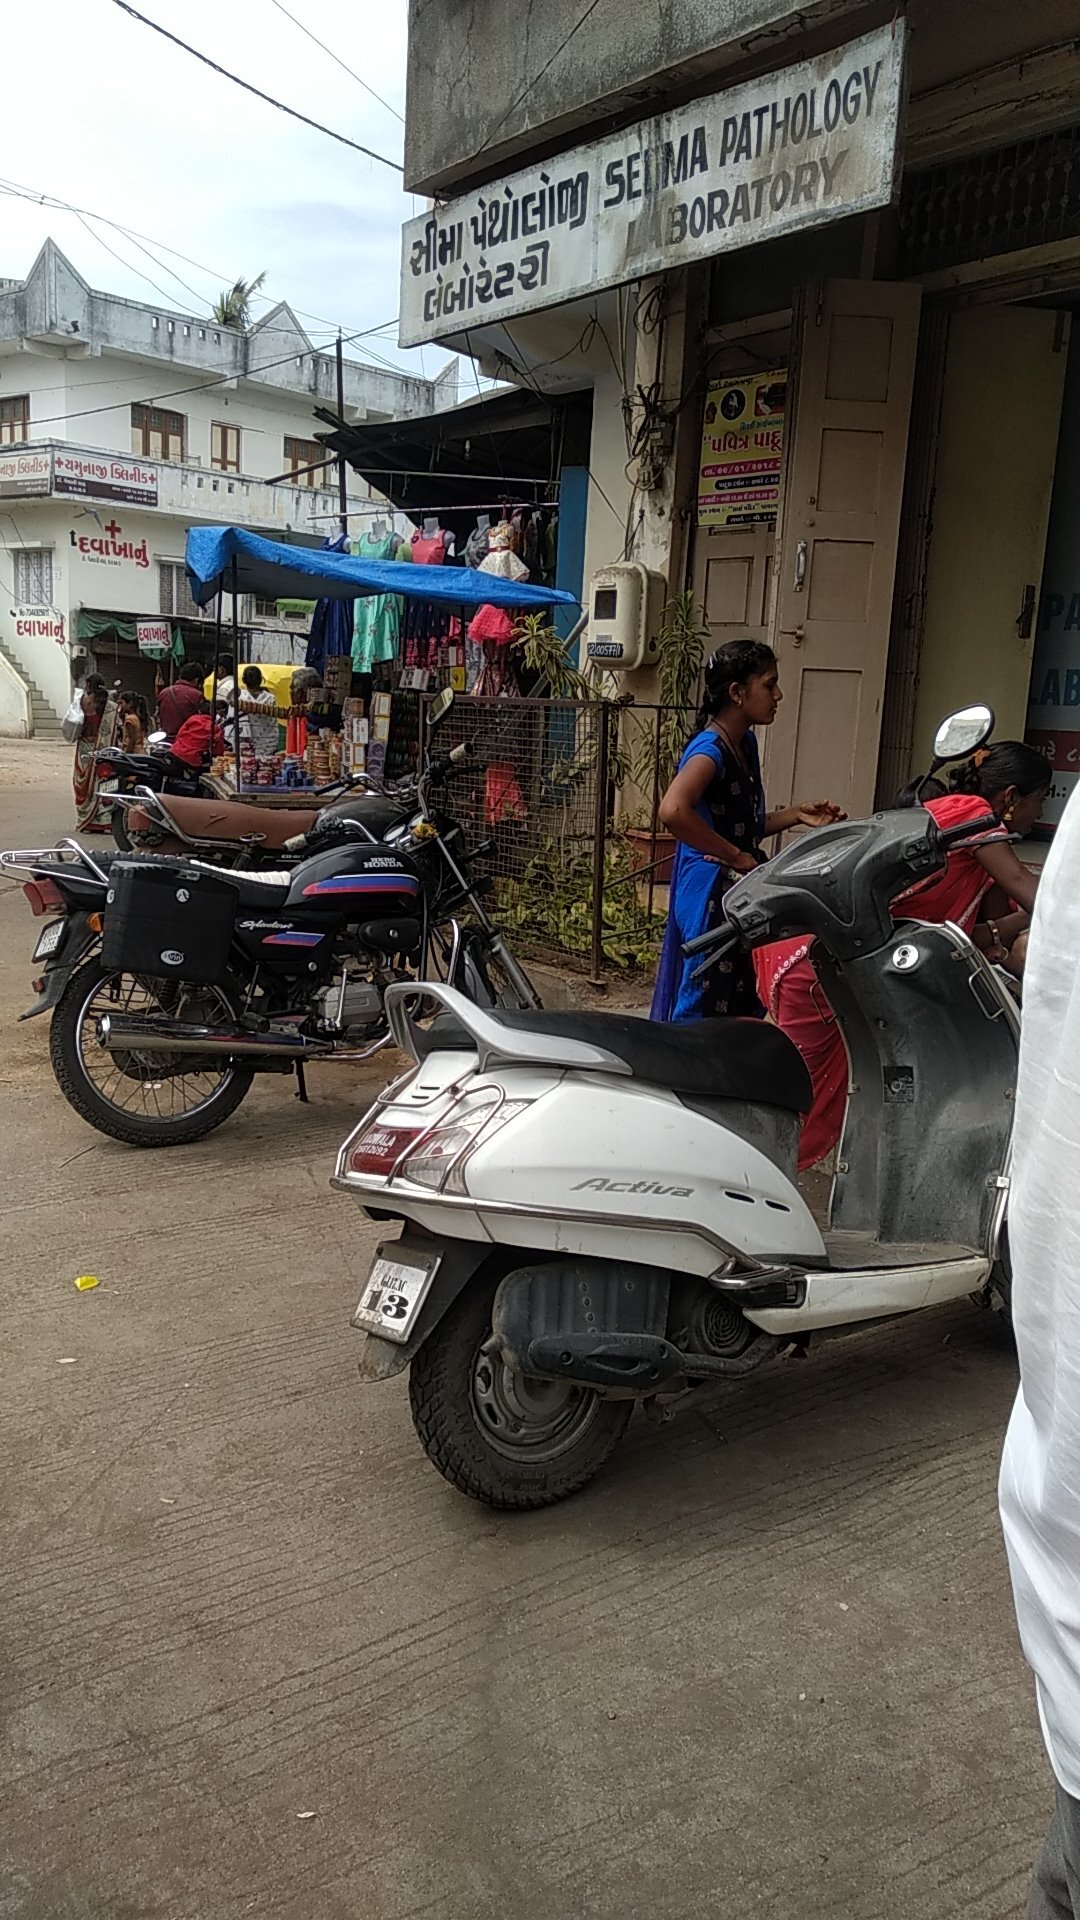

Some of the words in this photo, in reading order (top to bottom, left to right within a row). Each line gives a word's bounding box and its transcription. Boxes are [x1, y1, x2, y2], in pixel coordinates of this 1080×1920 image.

[719, 61, 882, 167] PATHOLOGY
[410, 218, 463, 277] સીમા
[470, 171, 589, 251] પેથોલોજી
[423, 240, 550, 322] લેબોરેટરી
[79, 536, 149, 568] દવાખાનું
[16, 615, 65, 645] દવાખાનું
[1030, 669, 1080, 706] AB
[570, 1177, 696, 1199] Activa
